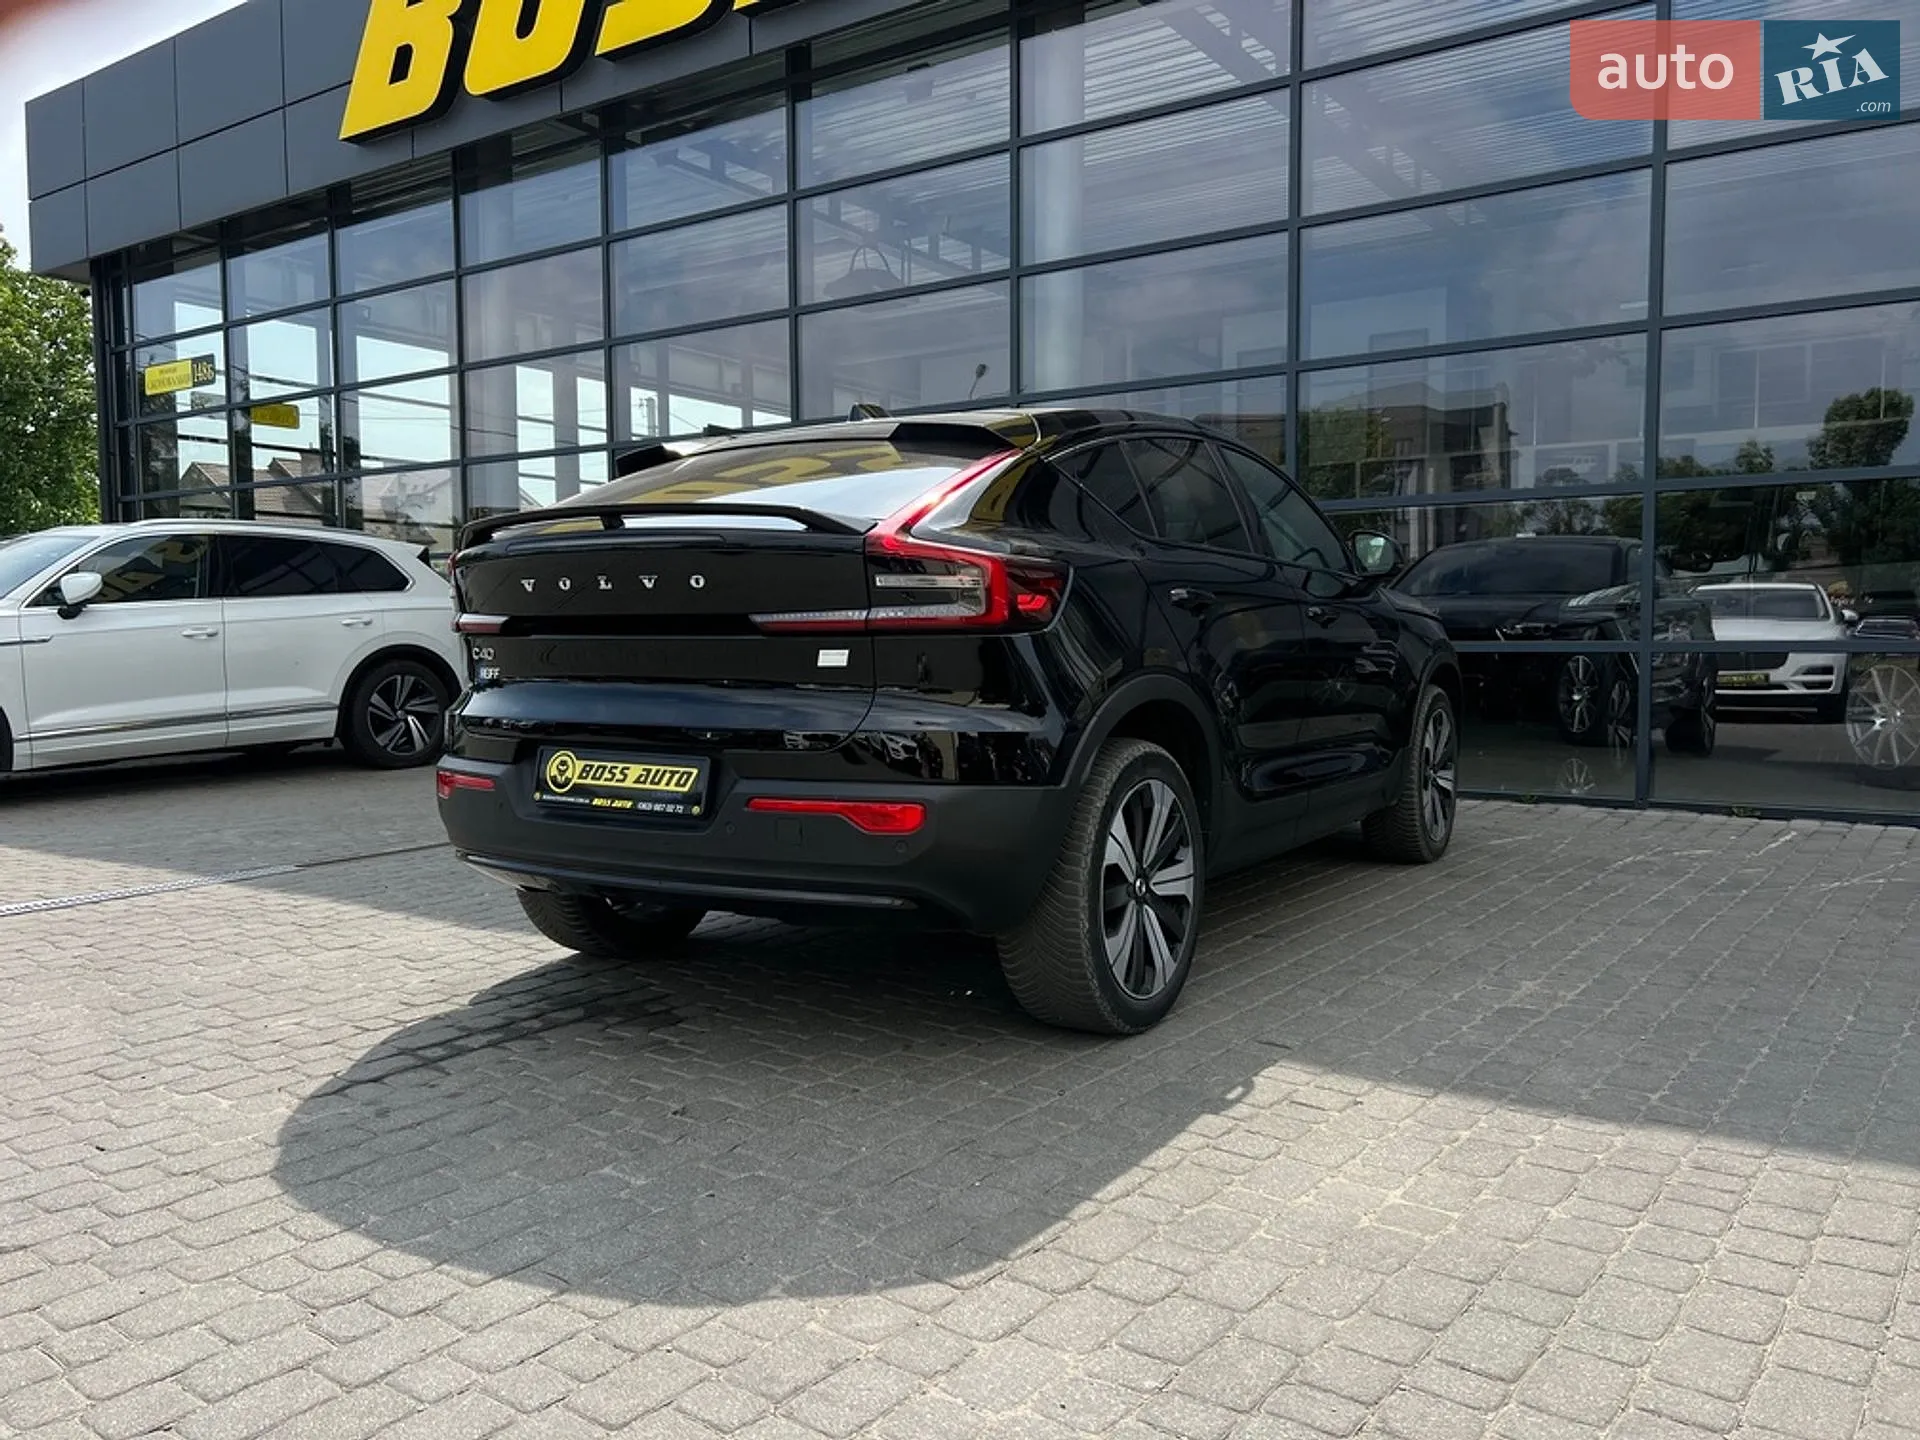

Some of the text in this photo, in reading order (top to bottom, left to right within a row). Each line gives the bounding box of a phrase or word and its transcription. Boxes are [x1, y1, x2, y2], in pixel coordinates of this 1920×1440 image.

[521, 575, 706, 592] VOLVO
[472, 648, 495, 660] C40
[577, 764, 694, 788] BOSS AUTO
